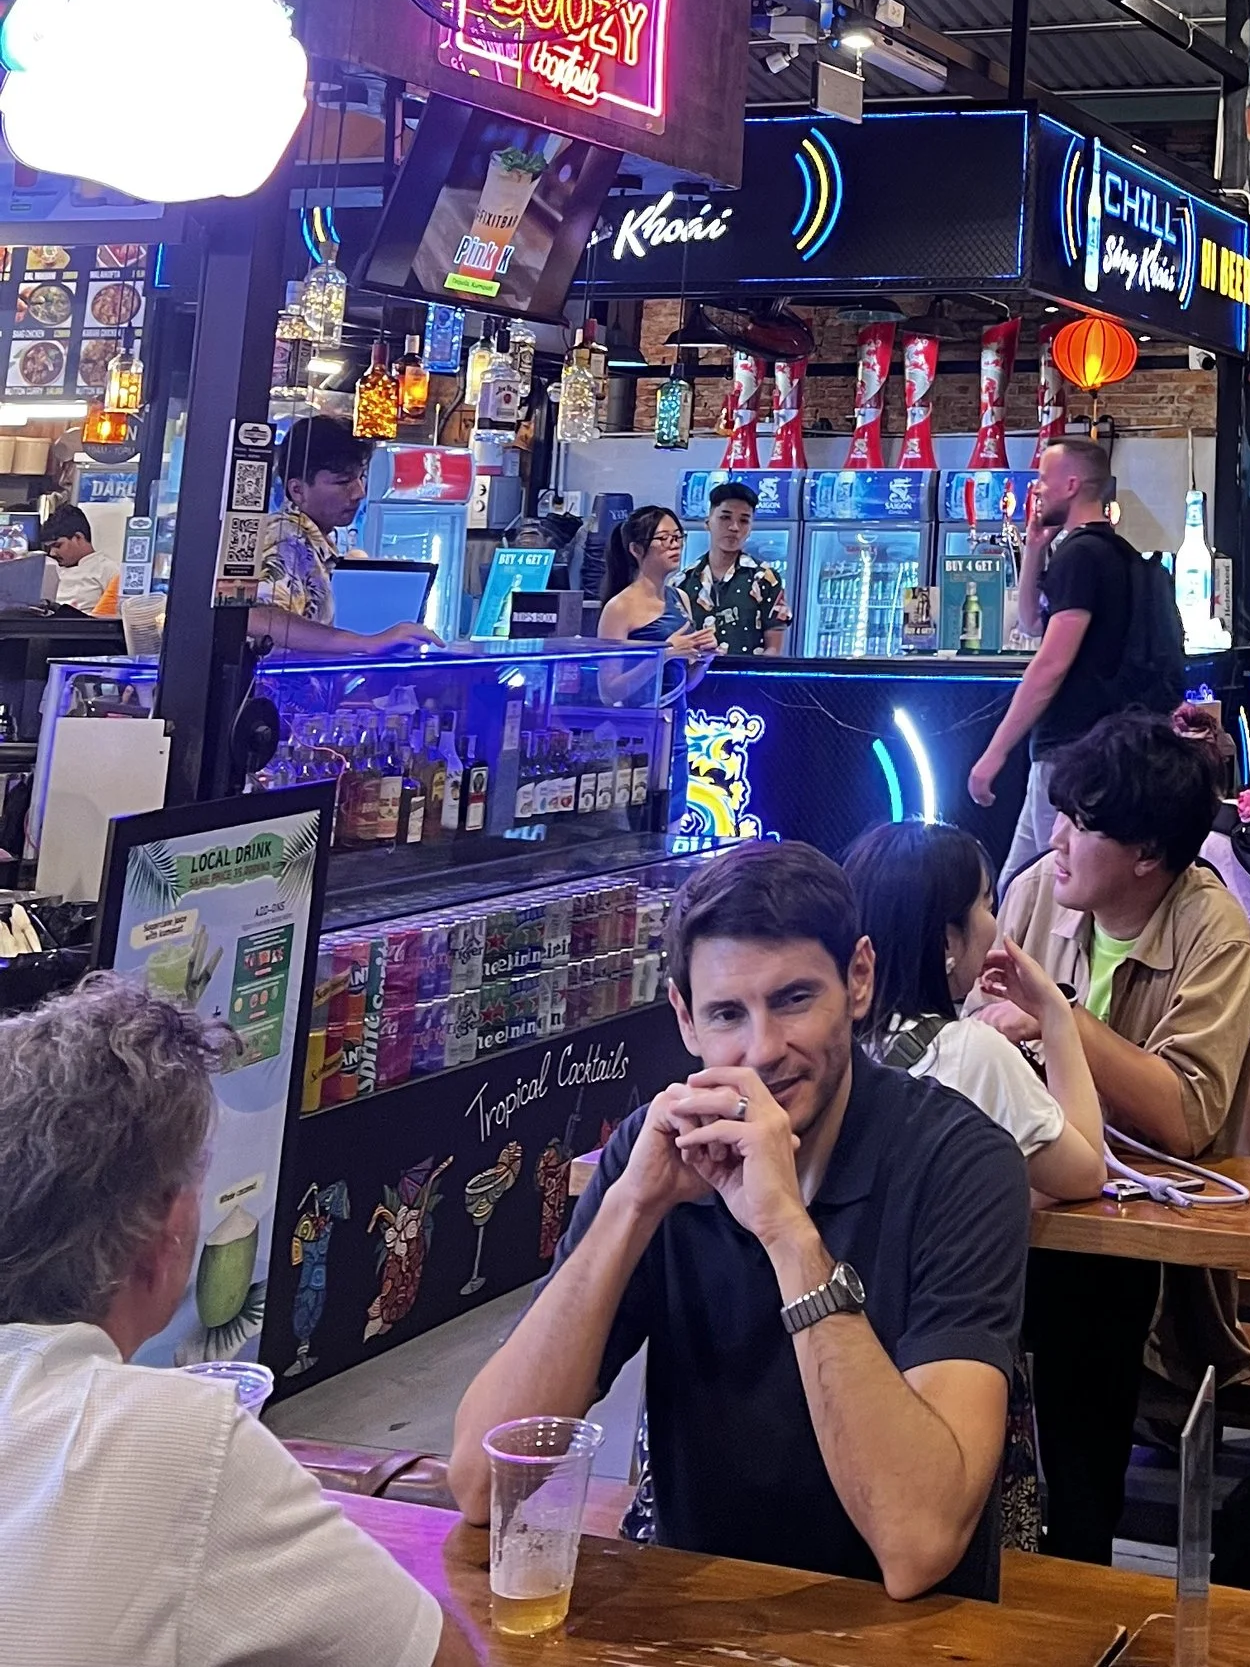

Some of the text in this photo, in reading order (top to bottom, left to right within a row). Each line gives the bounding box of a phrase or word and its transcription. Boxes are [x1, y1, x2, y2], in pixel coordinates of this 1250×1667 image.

[1103, 170, 1177, 246] CHILL
[453, 235, 498, 271] Pink
[1201, 237, 1218, 292] HI
[755, 501, 780, 509] AIGON
[884, 502, 912, 510] SAIGON
[499, 553, 515, 565] BUY
[525, 554, 541, 566] GET
[945, 560, 963, 572] BUY
[965, 560, 973, 572] 4
[974, 560, 993, 572] GET
[191, 841, 272, 874] LOCAL DRINK
[465, 1041, 629, 1142] Tropical Cocktails
